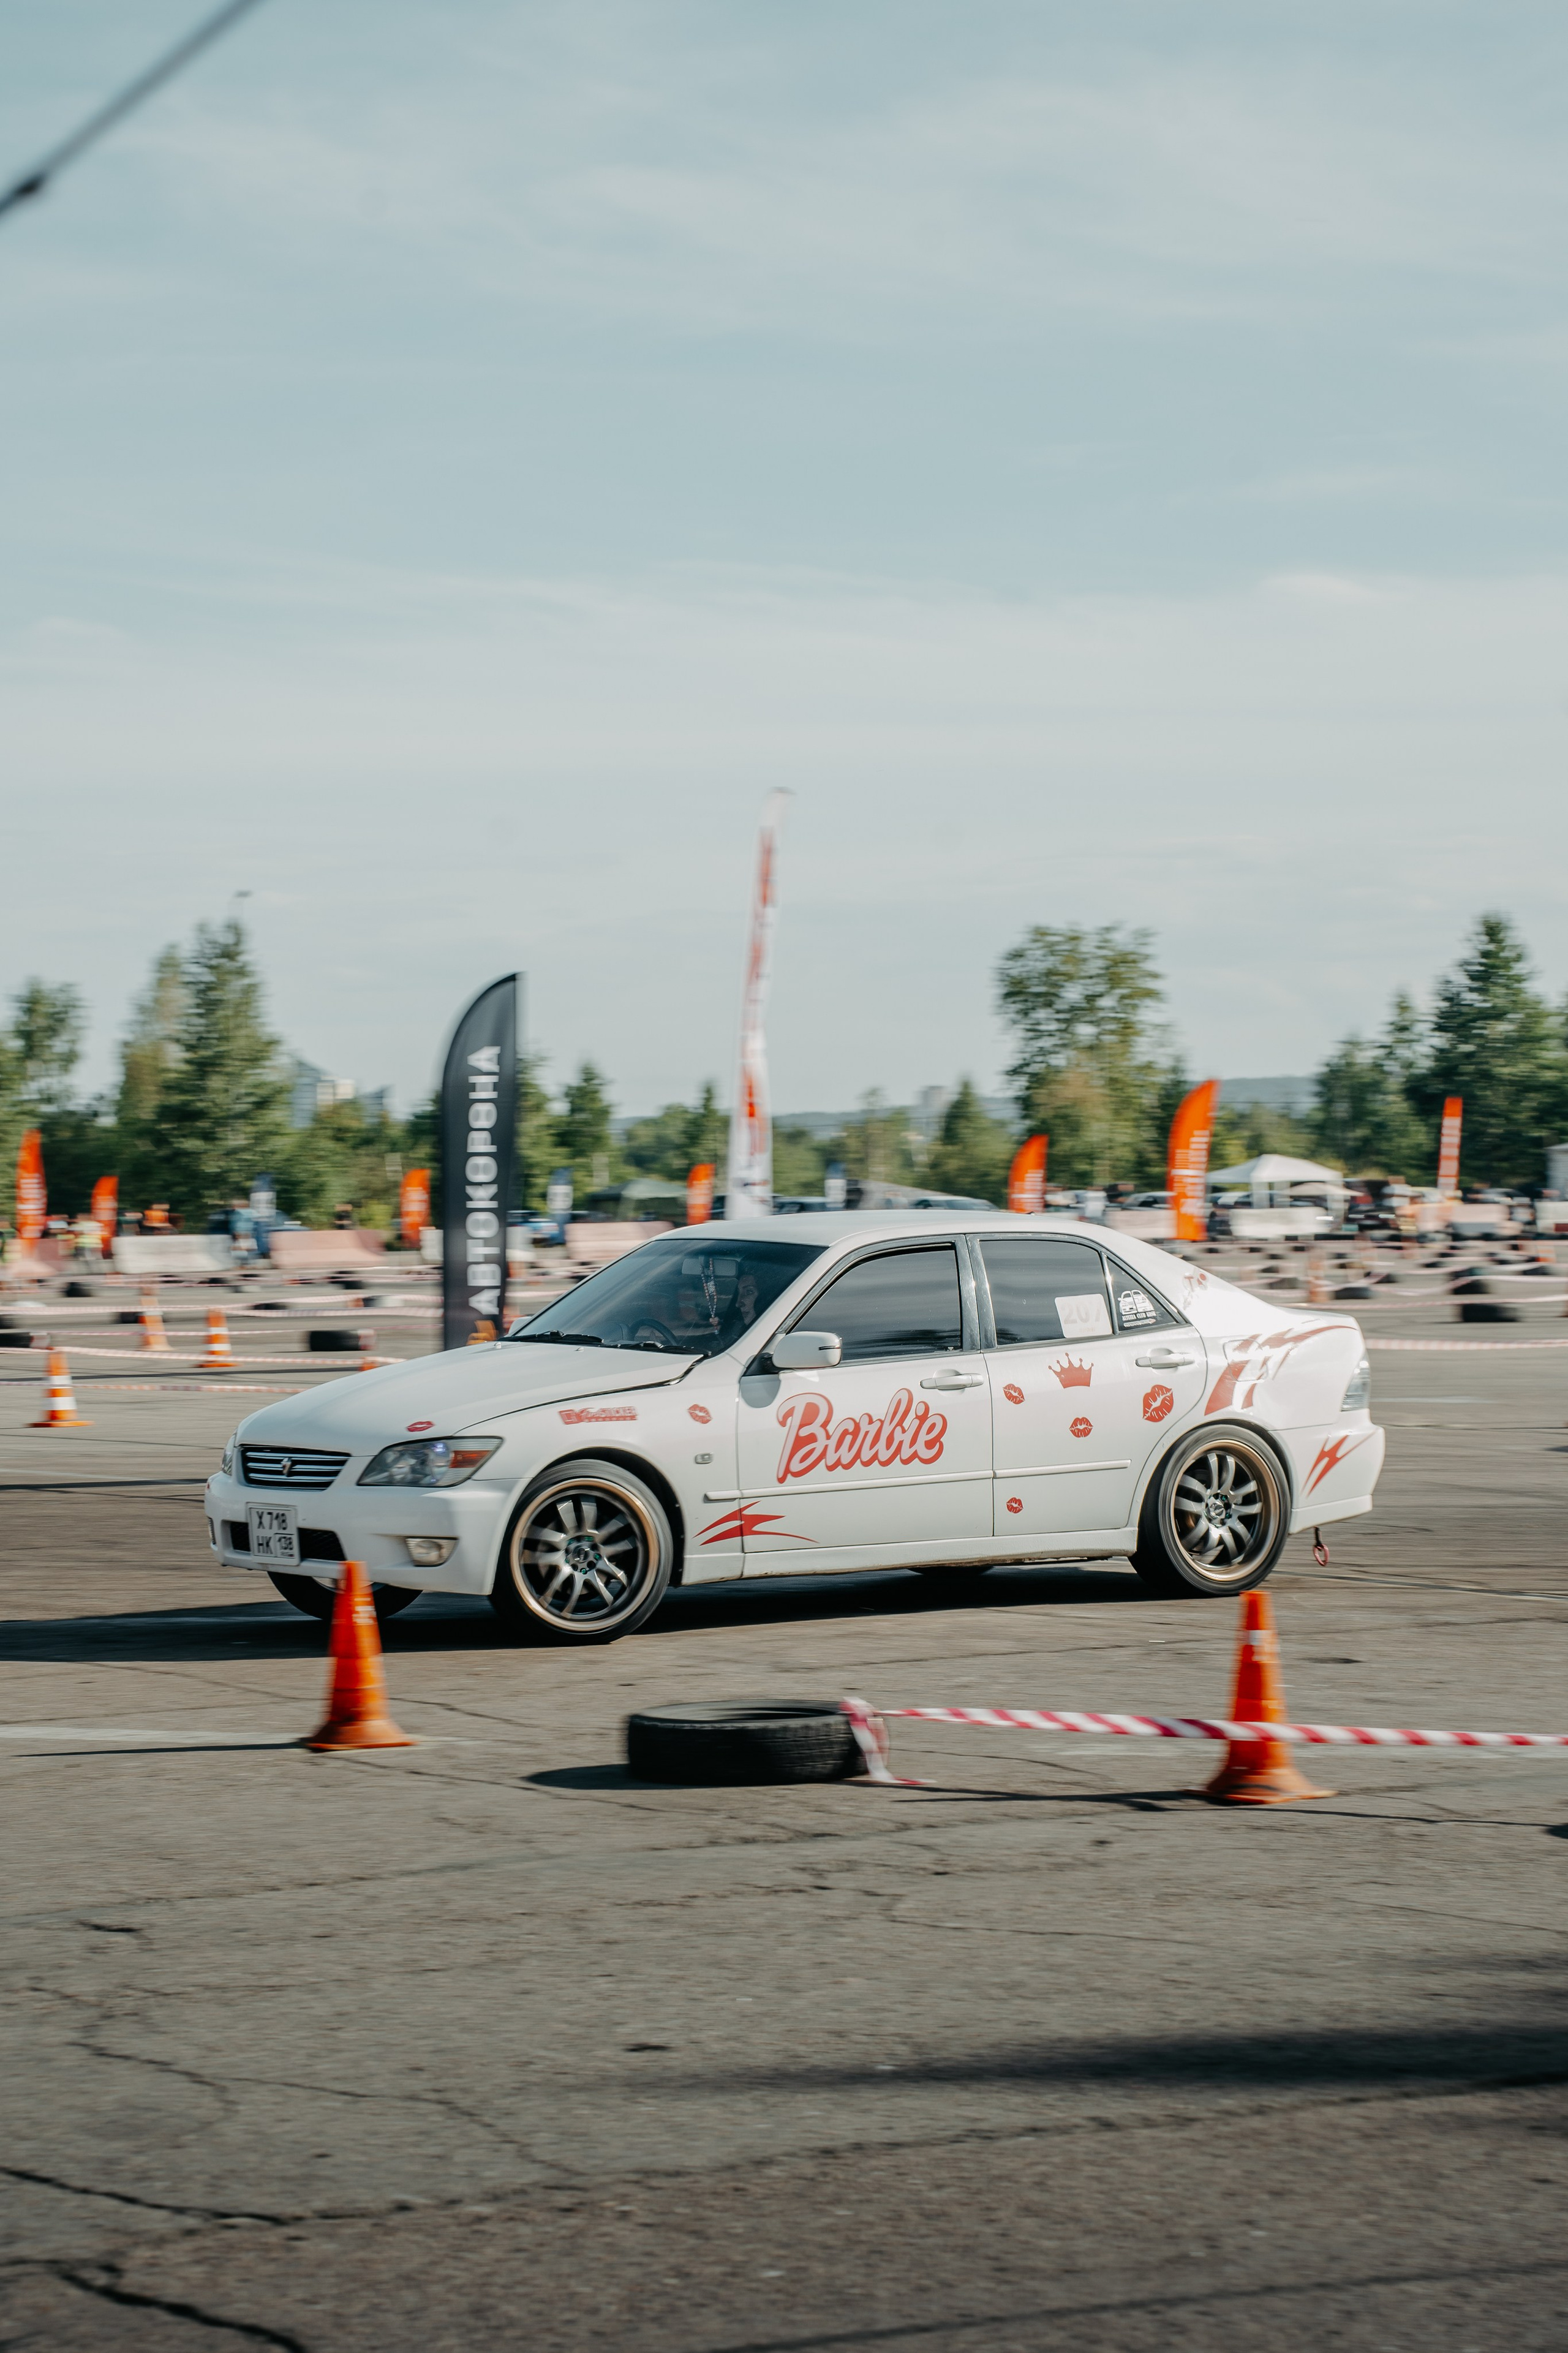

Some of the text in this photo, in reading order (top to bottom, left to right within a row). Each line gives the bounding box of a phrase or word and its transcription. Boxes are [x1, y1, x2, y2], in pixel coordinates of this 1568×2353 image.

[466, 1046, 502, 1315] АВТОКОРОНА
[1061, 1302, 1102, 1324] 207
[777, 1388, 948, 1484] Barbie
